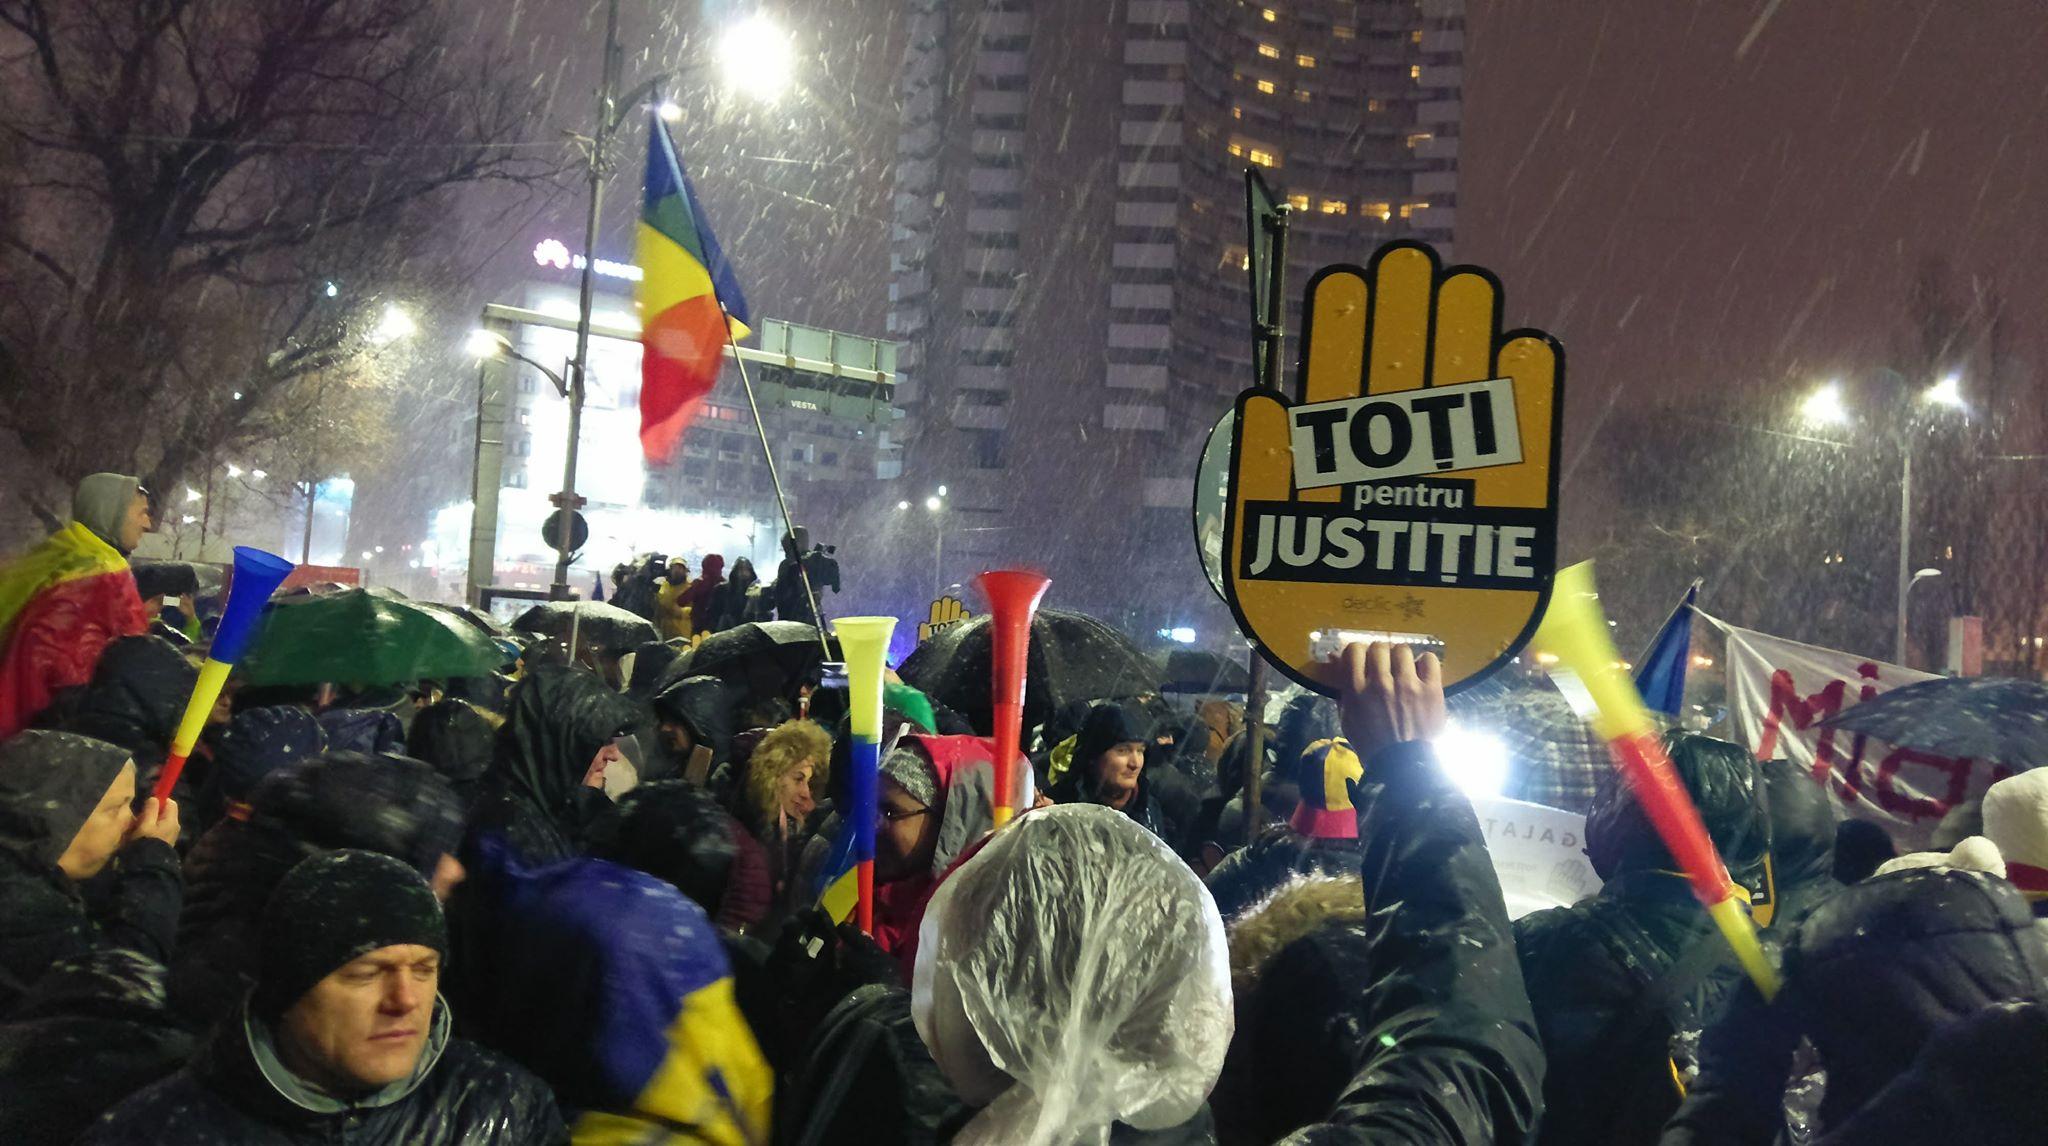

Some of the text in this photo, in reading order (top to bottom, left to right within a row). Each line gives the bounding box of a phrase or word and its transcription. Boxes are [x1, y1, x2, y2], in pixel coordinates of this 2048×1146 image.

[790, 399, 817, 411] VESTA
[1296, 390, 1497, 474] TOȚI
[1354, 482, 1463, 510] pentru
[1250, 514, 1537, 583] JUSTIȚIE
